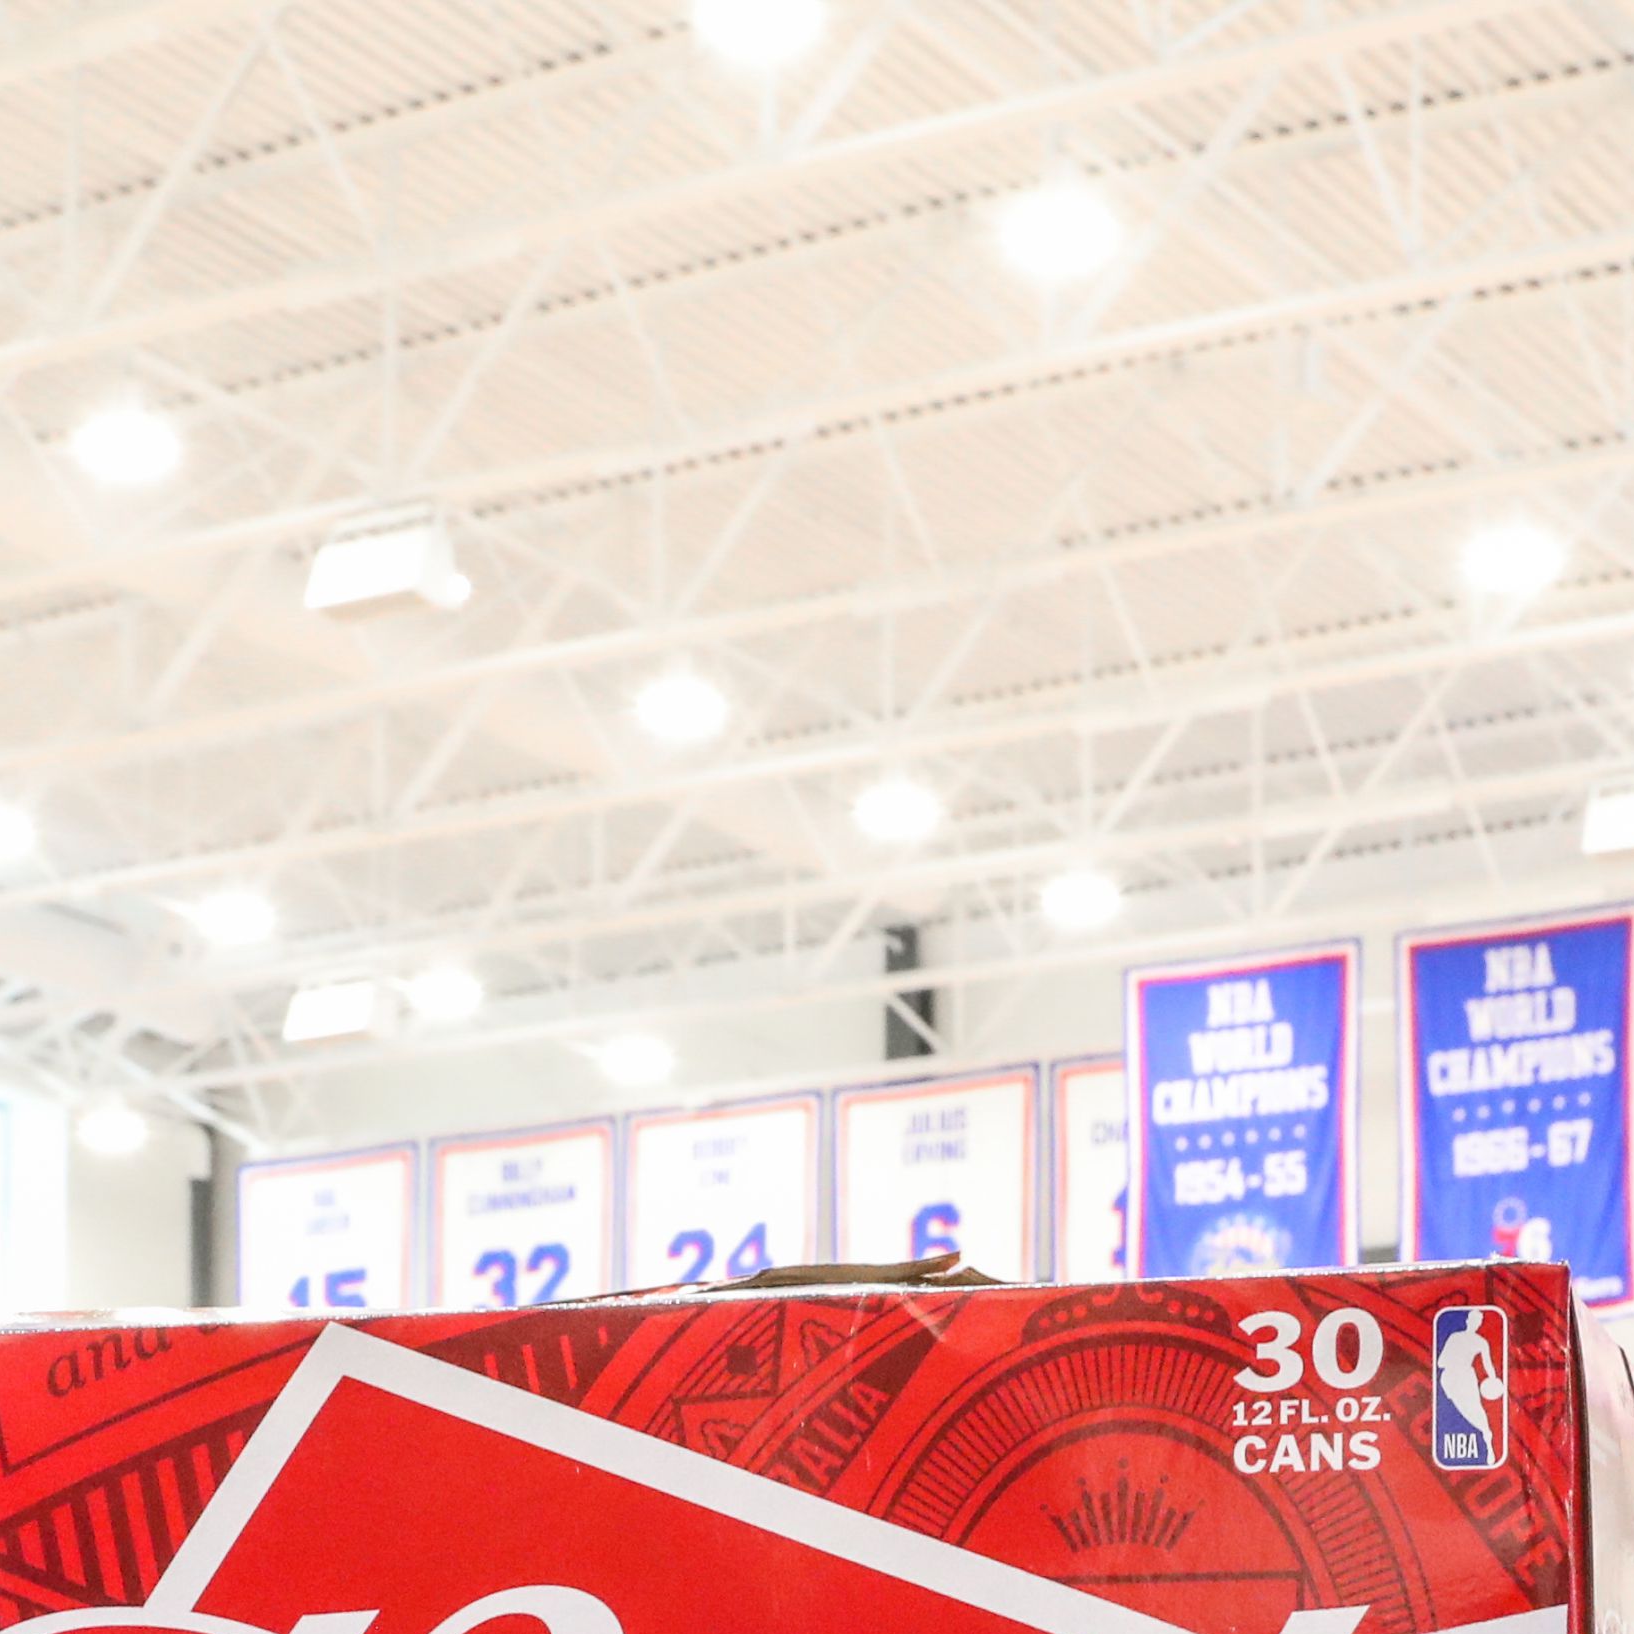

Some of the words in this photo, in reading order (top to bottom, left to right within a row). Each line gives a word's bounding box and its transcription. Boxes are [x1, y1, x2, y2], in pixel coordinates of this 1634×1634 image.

[1484, 942, 1557, 993] NBA
[1206, 977, 1274, 1027] NBA
[1465, 986, 1578, 1042] WORLD
[1188, 1021, 1294, 1075] WORLD
[1426, 1028, 1616, 1098] CHAMPIONS
[1151, 1063, 1330, 1127] CHAMPIONS
[668, 1222, 775, 1284] 24
[910, 1202, 961, 1260] 6
[288, 1268, 368, 1307] 15
[474, 1242, 571, 1307] 32
[1232, 1306, 1385, 1393] 30
[1232, 1401, 1273, 1427] 12
[1279, 1398, 1331, 1427] FL.
[1338, 1396, 1392, 1425] OZ.
[1232, 1432, 1382, 1475] CANS
[1443, 1433, 1479, 1461] NBA
